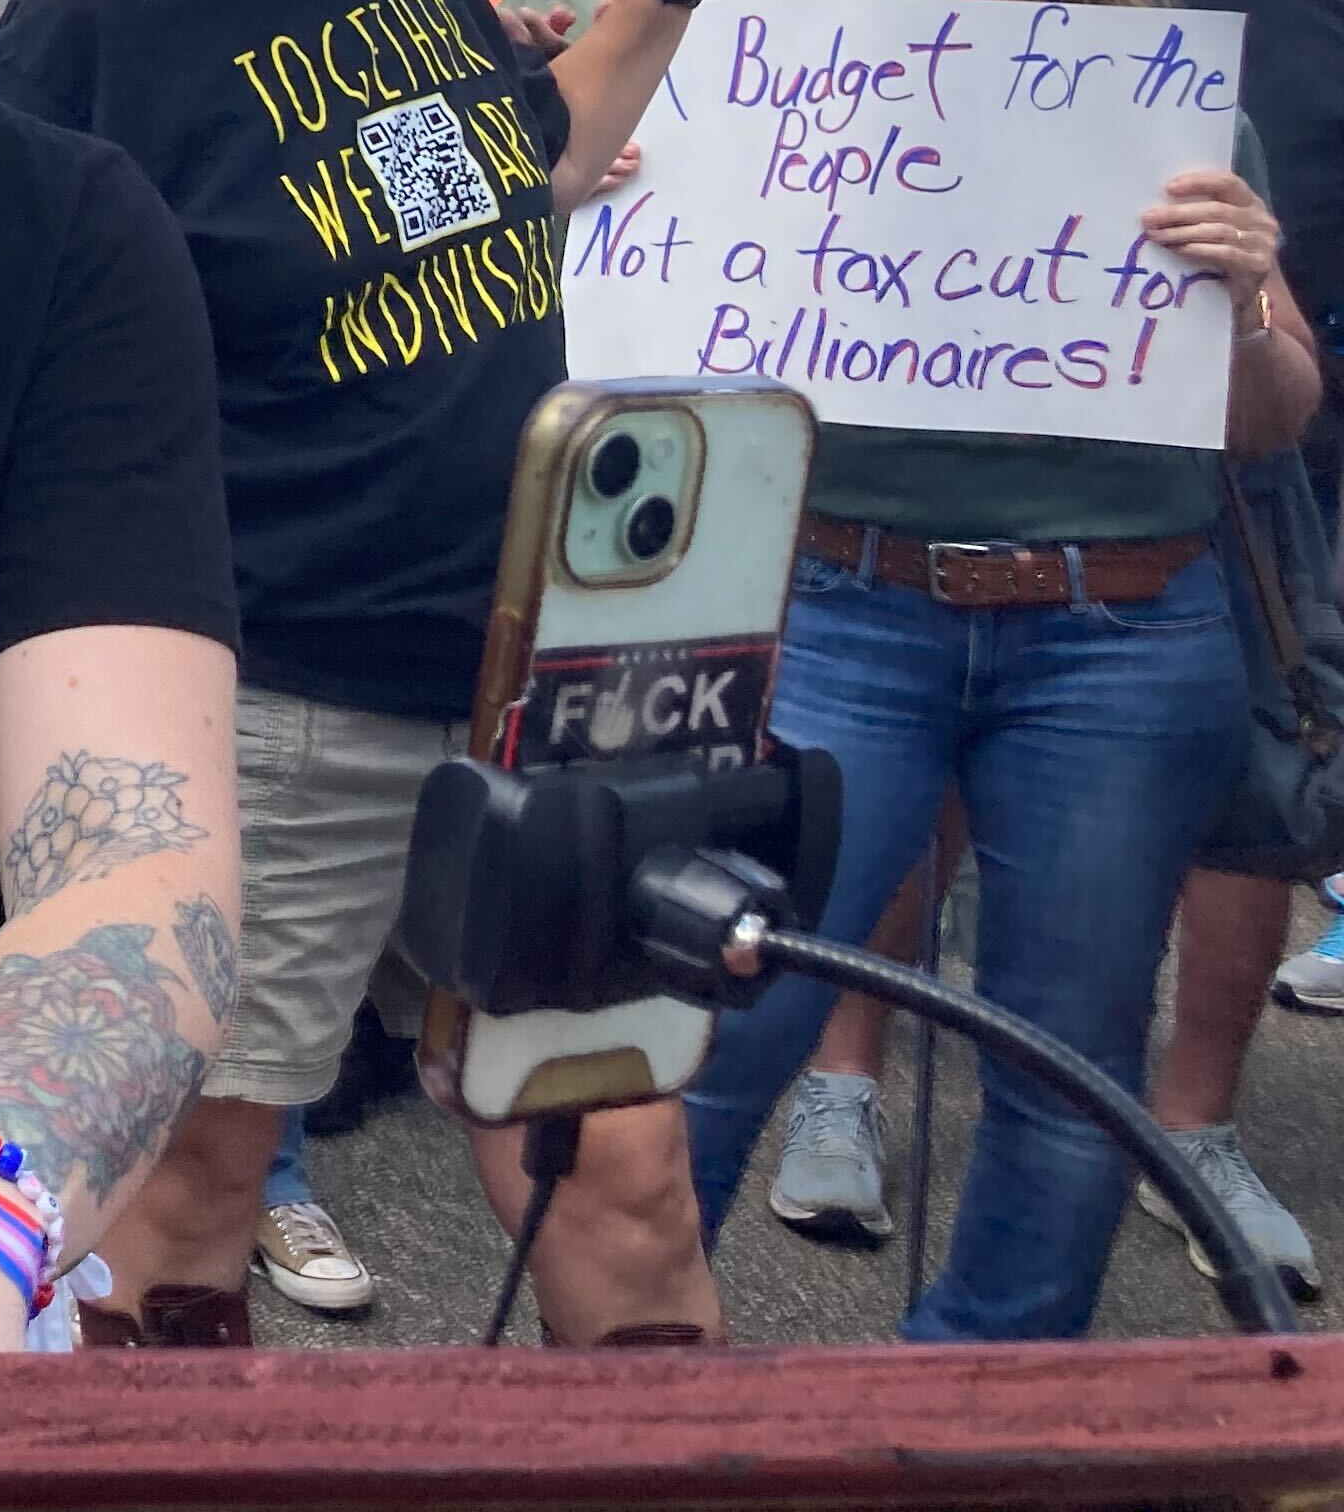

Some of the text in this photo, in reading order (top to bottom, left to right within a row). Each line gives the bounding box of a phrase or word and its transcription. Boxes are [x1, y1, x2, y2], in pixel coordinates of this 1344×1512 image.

[727, 14, 973, 134] Budget
[1004, 4, 1113, 112] for
[1127, 22, 1237, 114] the
[280, 147, 391, 262] WE
[760, 107, 963, 212] People
[573, 190, 1227, 311] Not a tax cut for
[697, 302, 1159, 393] Billionaires!
[549, 670, 737, 751] FCK
